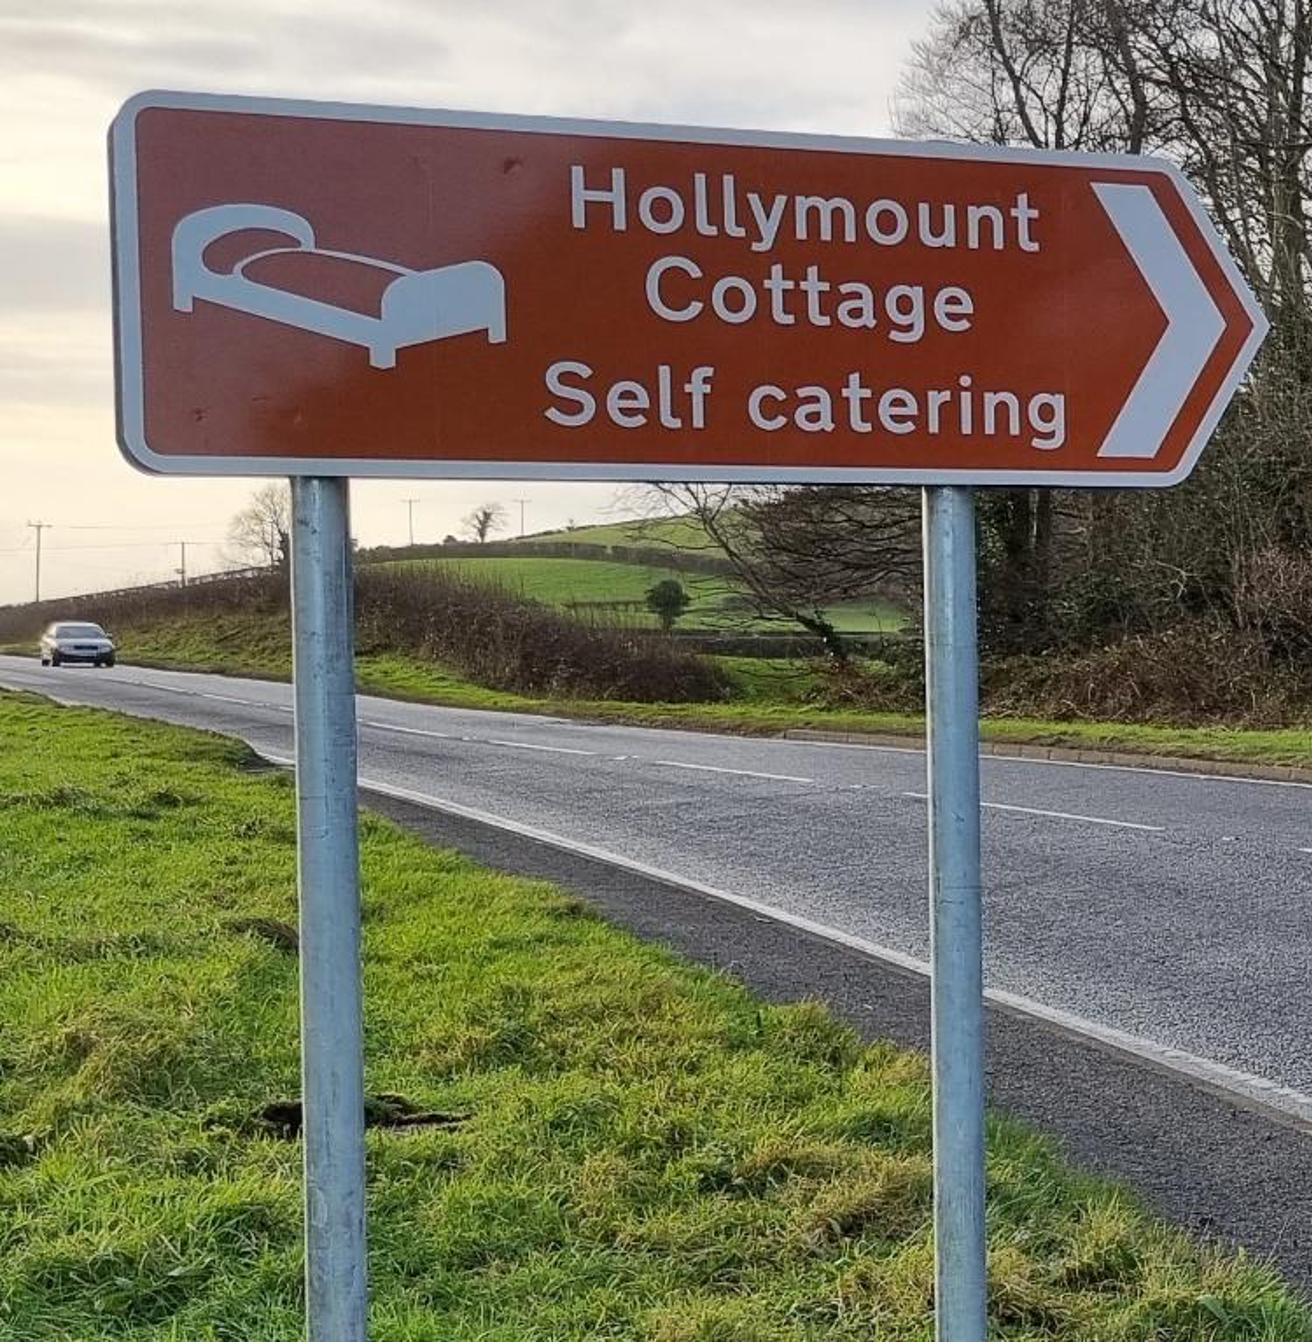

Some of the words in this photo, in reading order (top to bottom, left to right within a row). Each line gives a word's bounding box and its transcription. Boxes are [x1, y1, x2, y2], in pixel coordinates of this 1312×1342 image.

[570, 164, 1041, 252] Hollymount
[645, 255, 975, 343] Cottage
[544, 361, 715, 429] Self
[747, 371, 1066, 450] catering
